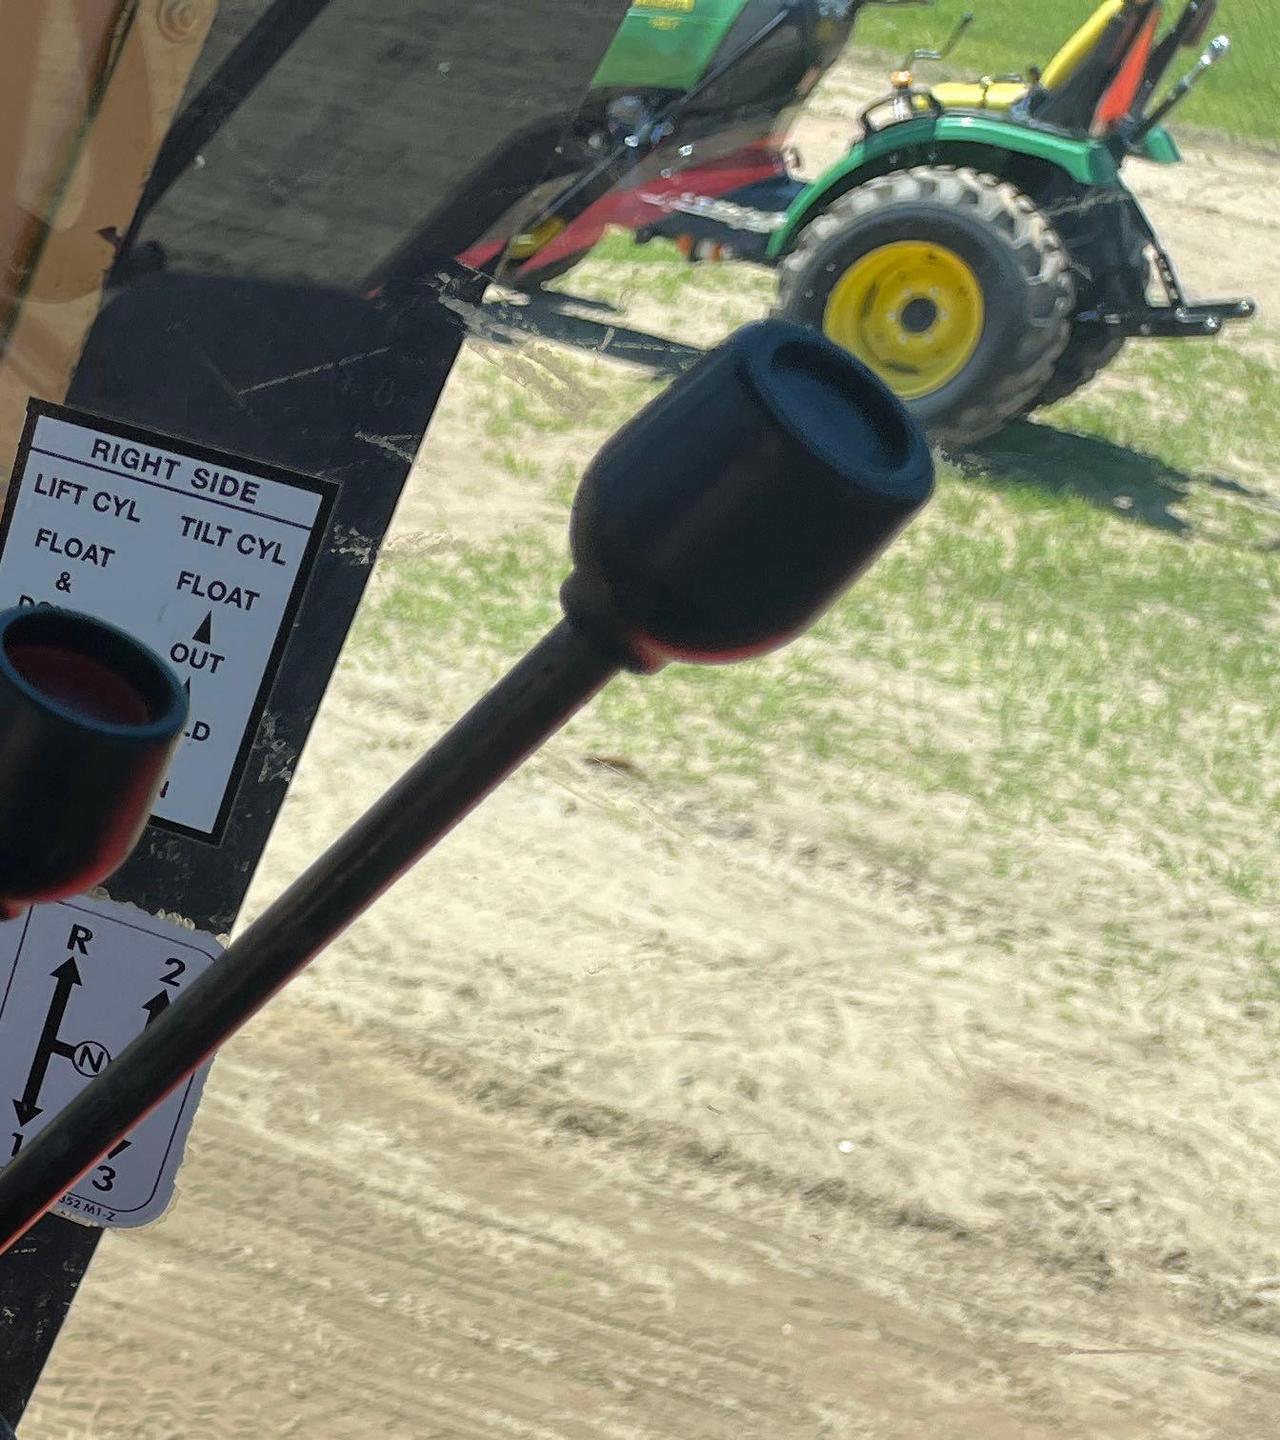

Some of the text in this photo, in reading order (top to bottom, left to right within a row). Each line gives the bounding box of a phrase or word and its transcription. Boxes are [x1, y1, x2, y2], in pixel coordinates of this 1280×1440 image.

[90, 438, 260, 505] RIGHT SIDE
[34, 473, 140, 523] LIFT CYL
[34, 528, 115, 568] FLOAT
[180, 515, 286, 566] TILT CYL
[55, 571, 73, 593] &
[176, 570, 260, 611] FLOAT
[169, 642, 225, 674] OUT
[66, 924, 94, 956] R
[159, 957, 186, 987] 2
[79, 1046, 105, 1073] N
[92, 1165, 116, 1191] 3
